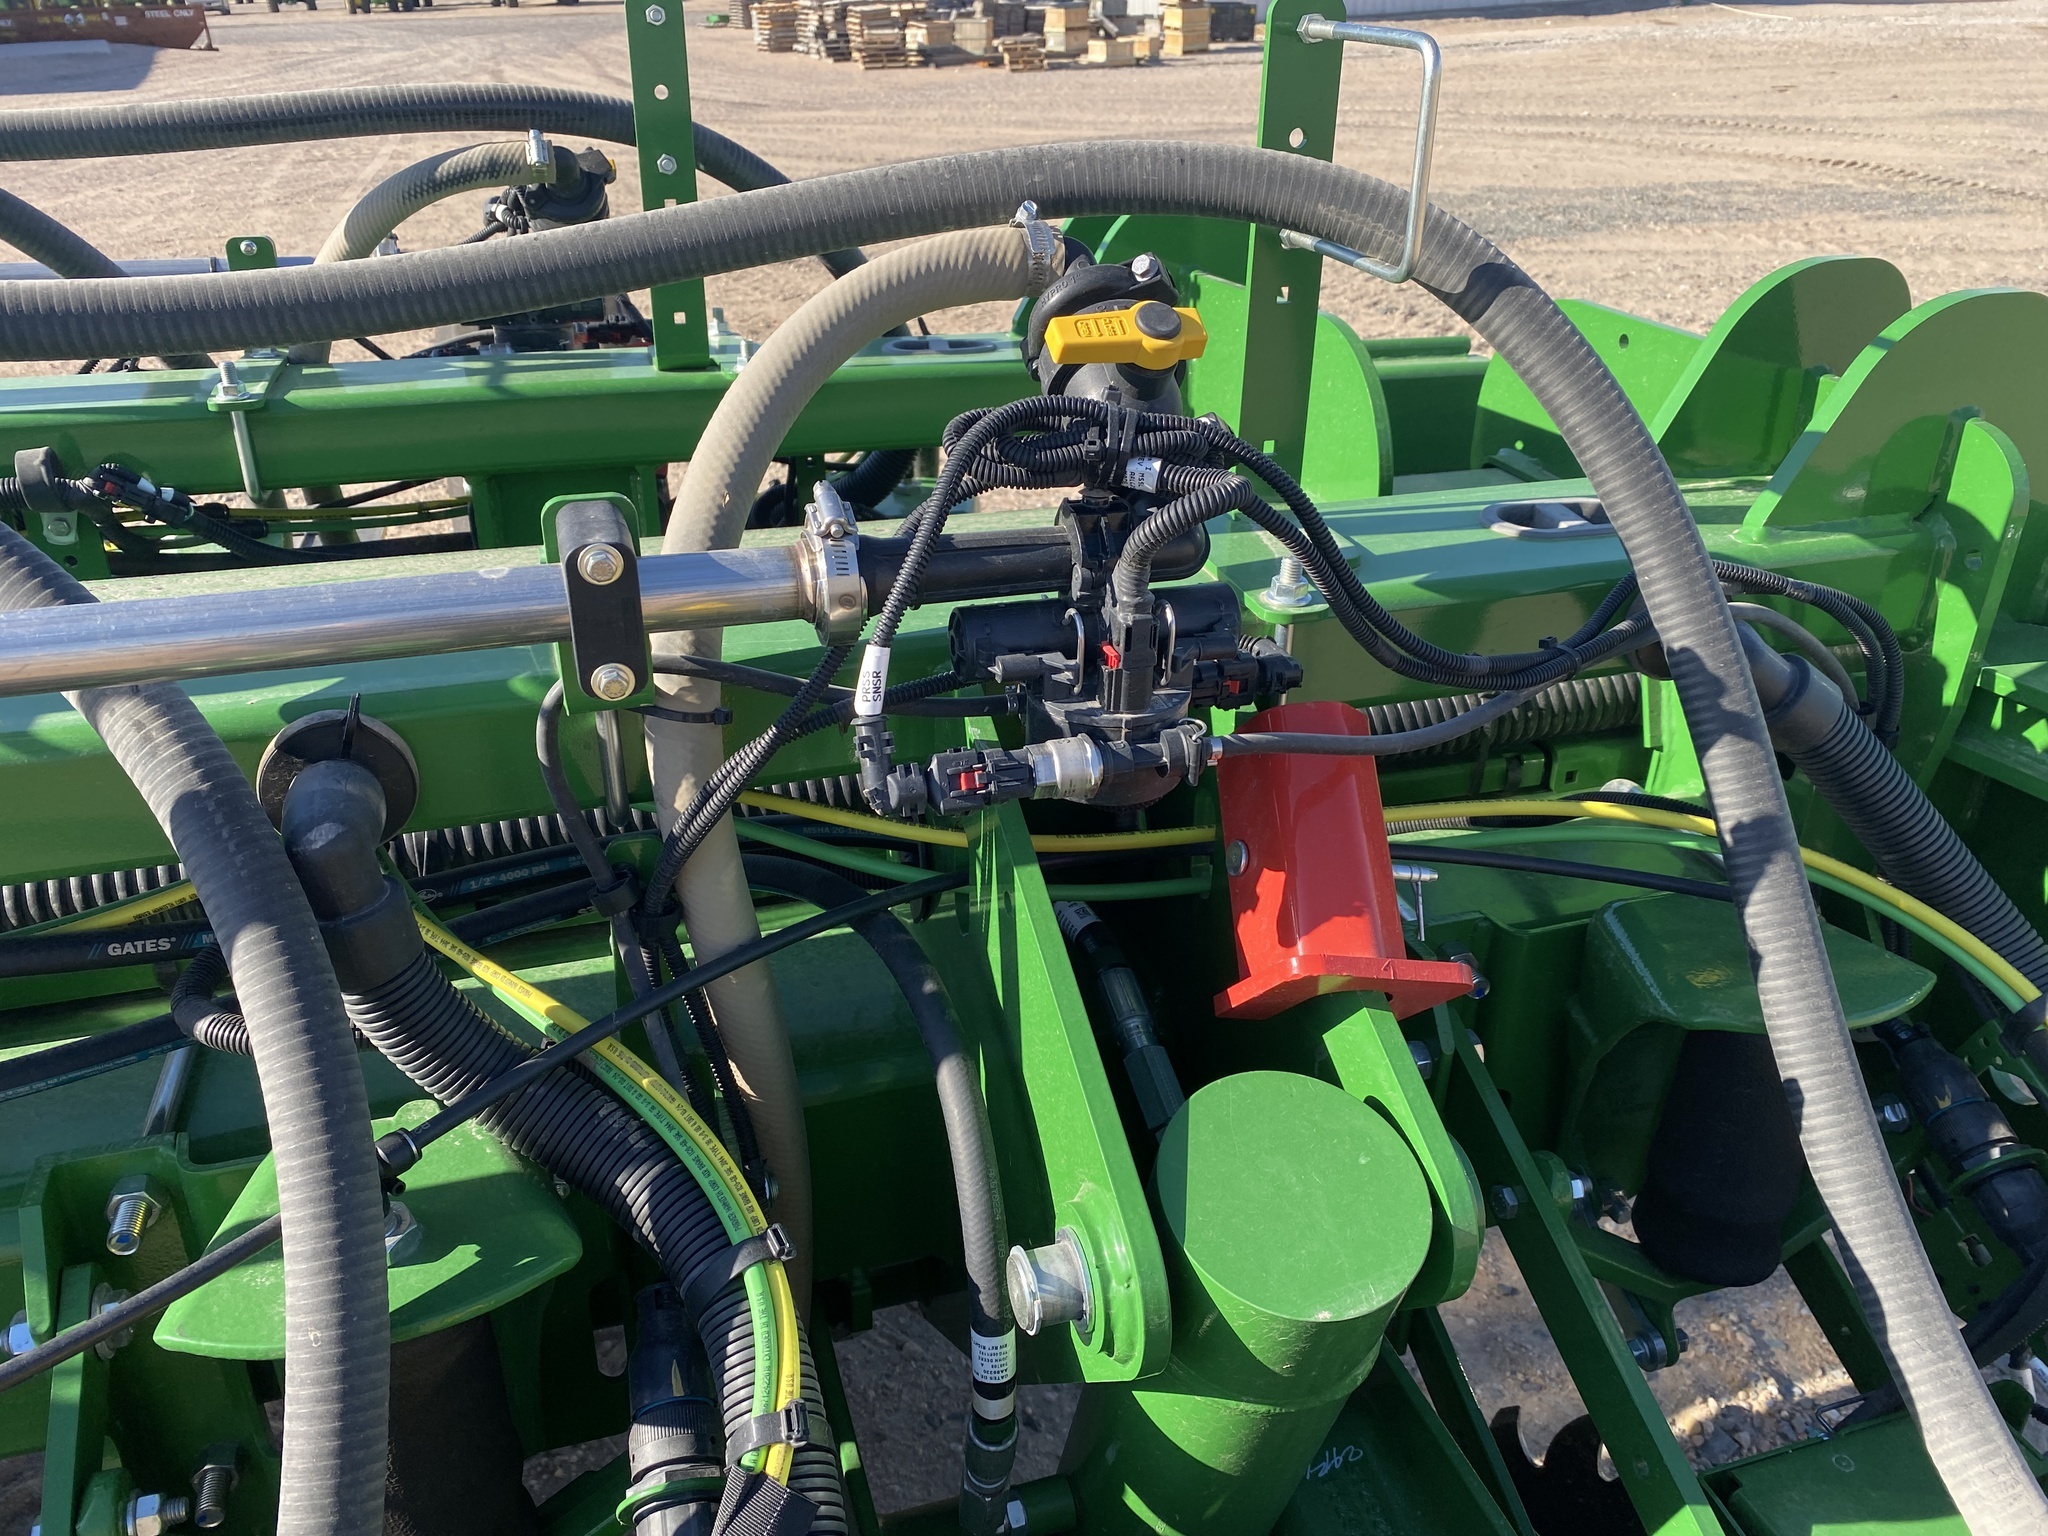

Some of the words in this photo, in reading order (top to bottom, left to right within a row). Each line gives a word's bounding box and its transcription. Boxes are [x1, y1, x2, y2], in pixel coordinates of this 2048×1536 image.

[145, 10, 170, 18] STEEL
[173, 8, 194, 17] ONLY
[1040, 280, 1069, 308] HYPRO
[862, 670, 871, 702] PRSS
[872, 670, 882, 702] SNSR
[802, 825, 830, 835] MSHA
[468, 874, 496, 890] 1/2"
[498, 867, 529, 882] 4000
[530, 861, 550, 874] psi
[622, 1081, 634, 1092] DOT
[652, 1110, 666, 1124] TYPE
[672, 1129, 683, 1141] SAE
[708, 1143, 722, 1157] TYPE
[690, 1153, 706, 1170] BRAKE
[700, 1167, 712, 1179] AIR
[714, 1188, 732, 1213] HANNIFIN
[727, 1211, 742, 1232] PARKER
[758, 1307, 767, 1319] THE
[761, 1330, 770, 1360] EXTRUDED
